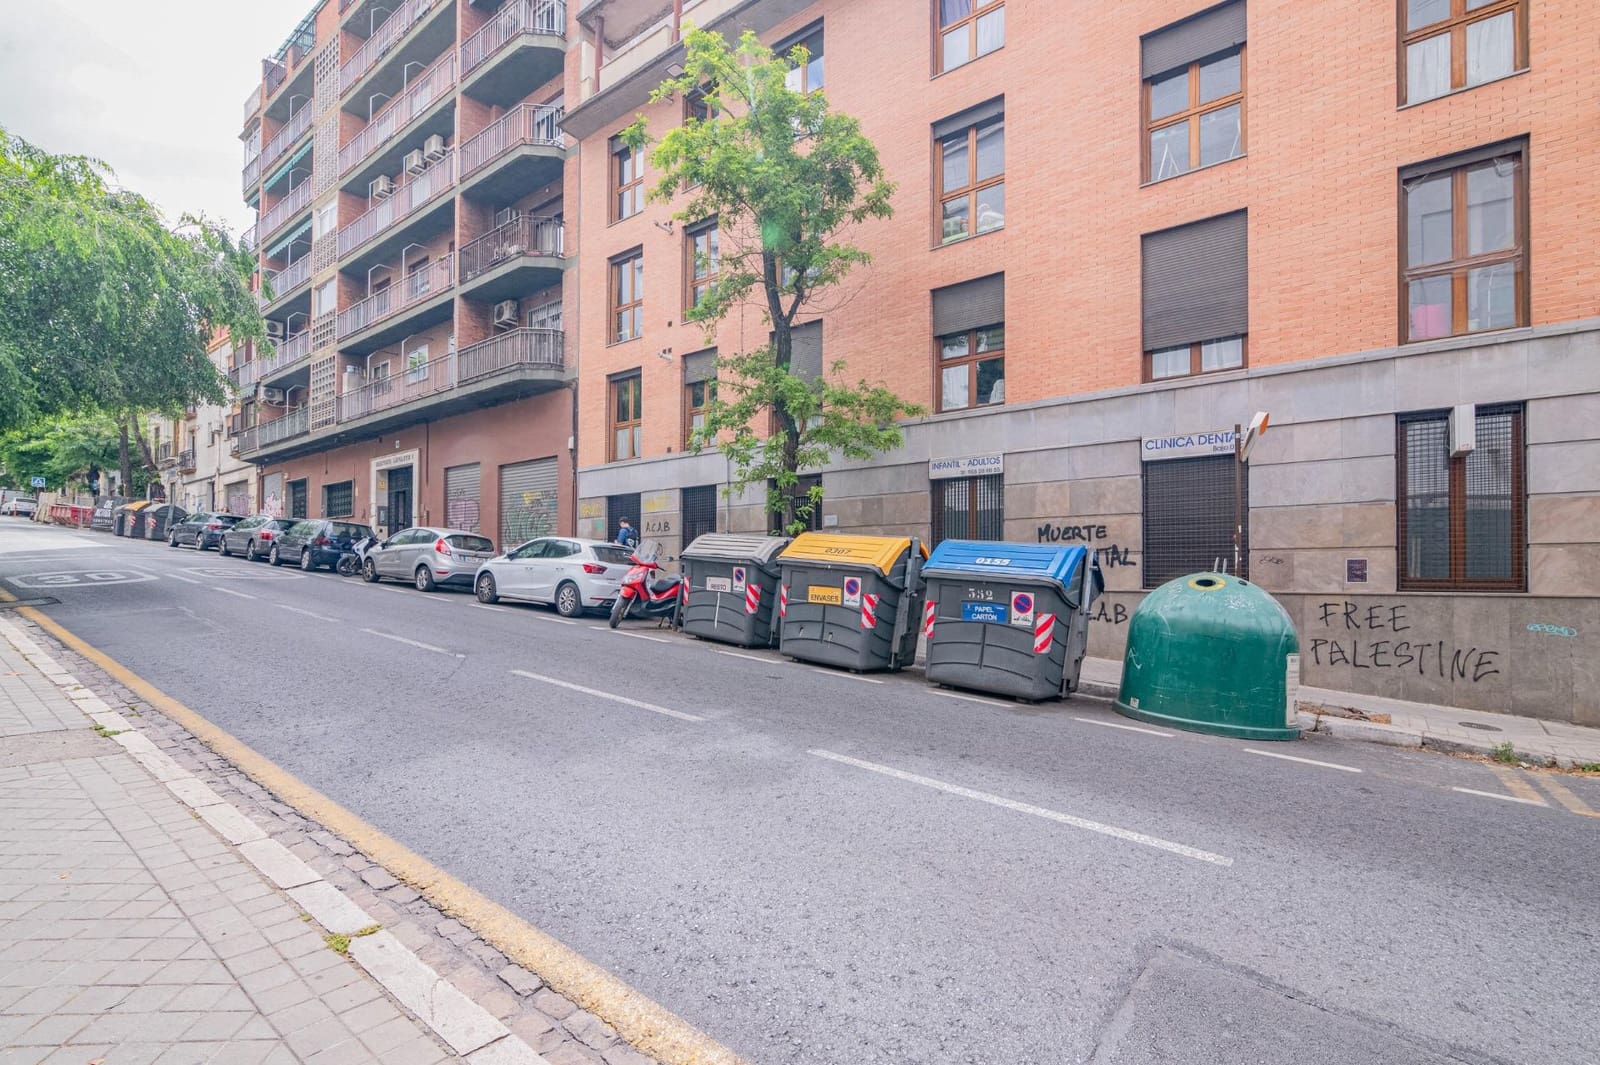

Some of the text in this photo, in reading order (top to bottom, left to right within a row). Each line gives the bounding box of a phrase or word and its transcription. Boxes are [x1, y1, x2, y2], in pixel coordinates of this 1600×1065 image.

[1145, 432, 1236, 450] CLINICA DENTA
[932, 460, 960, 471] INFANTIL
[968, 457, 1000, 467] ADULTOS
[1038, 524, 1107, 543] MUERTE
[811, 594, 839, 602] ENVASES
[1319, 601, 1410, 632] FREE
[1310, 638, 1500, 682] PALESTINE
